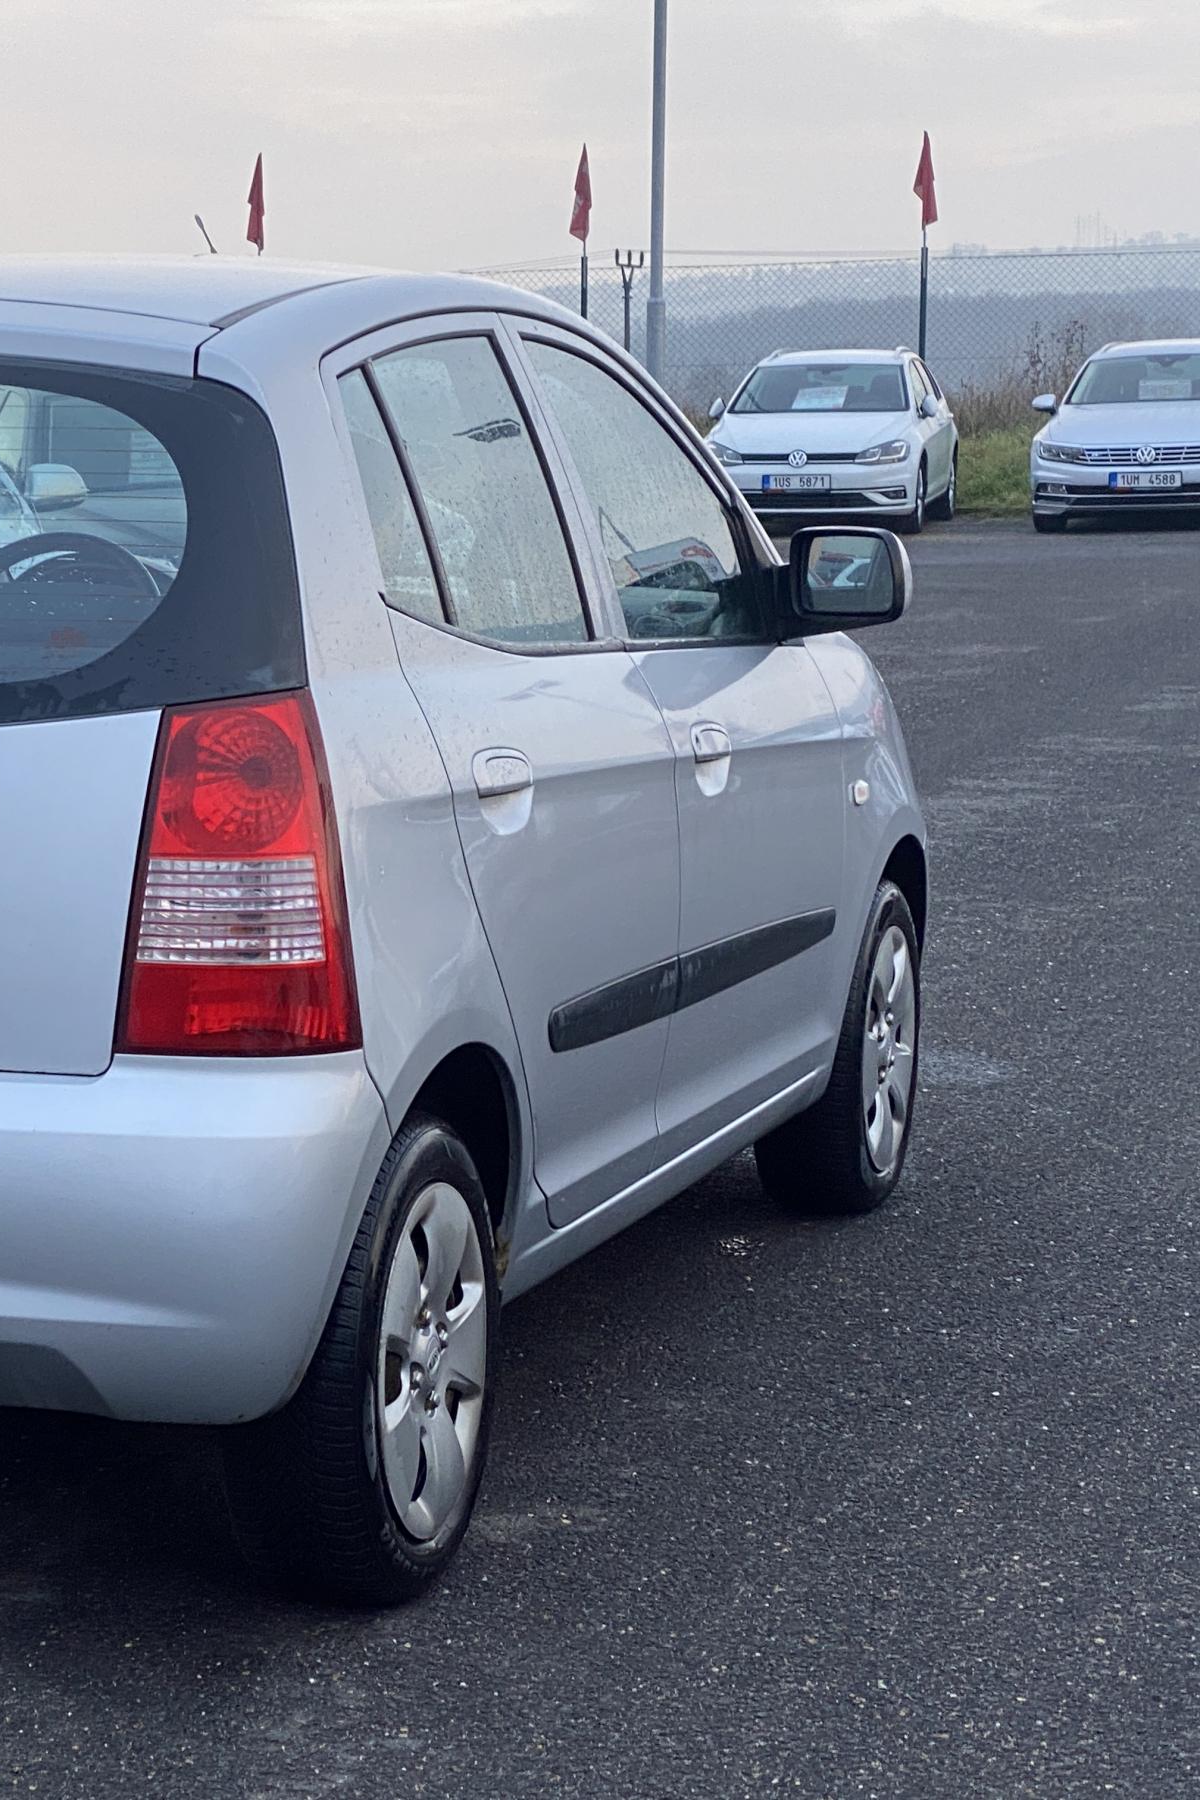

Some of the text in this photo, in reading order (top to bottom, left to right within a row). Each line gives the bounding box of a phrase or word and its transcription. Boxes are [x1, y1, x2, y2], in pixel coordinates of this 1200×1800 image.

[774, 476, 825, 487] 1US 5871
[1121, 474, 1176, 485] 1UM 4588
